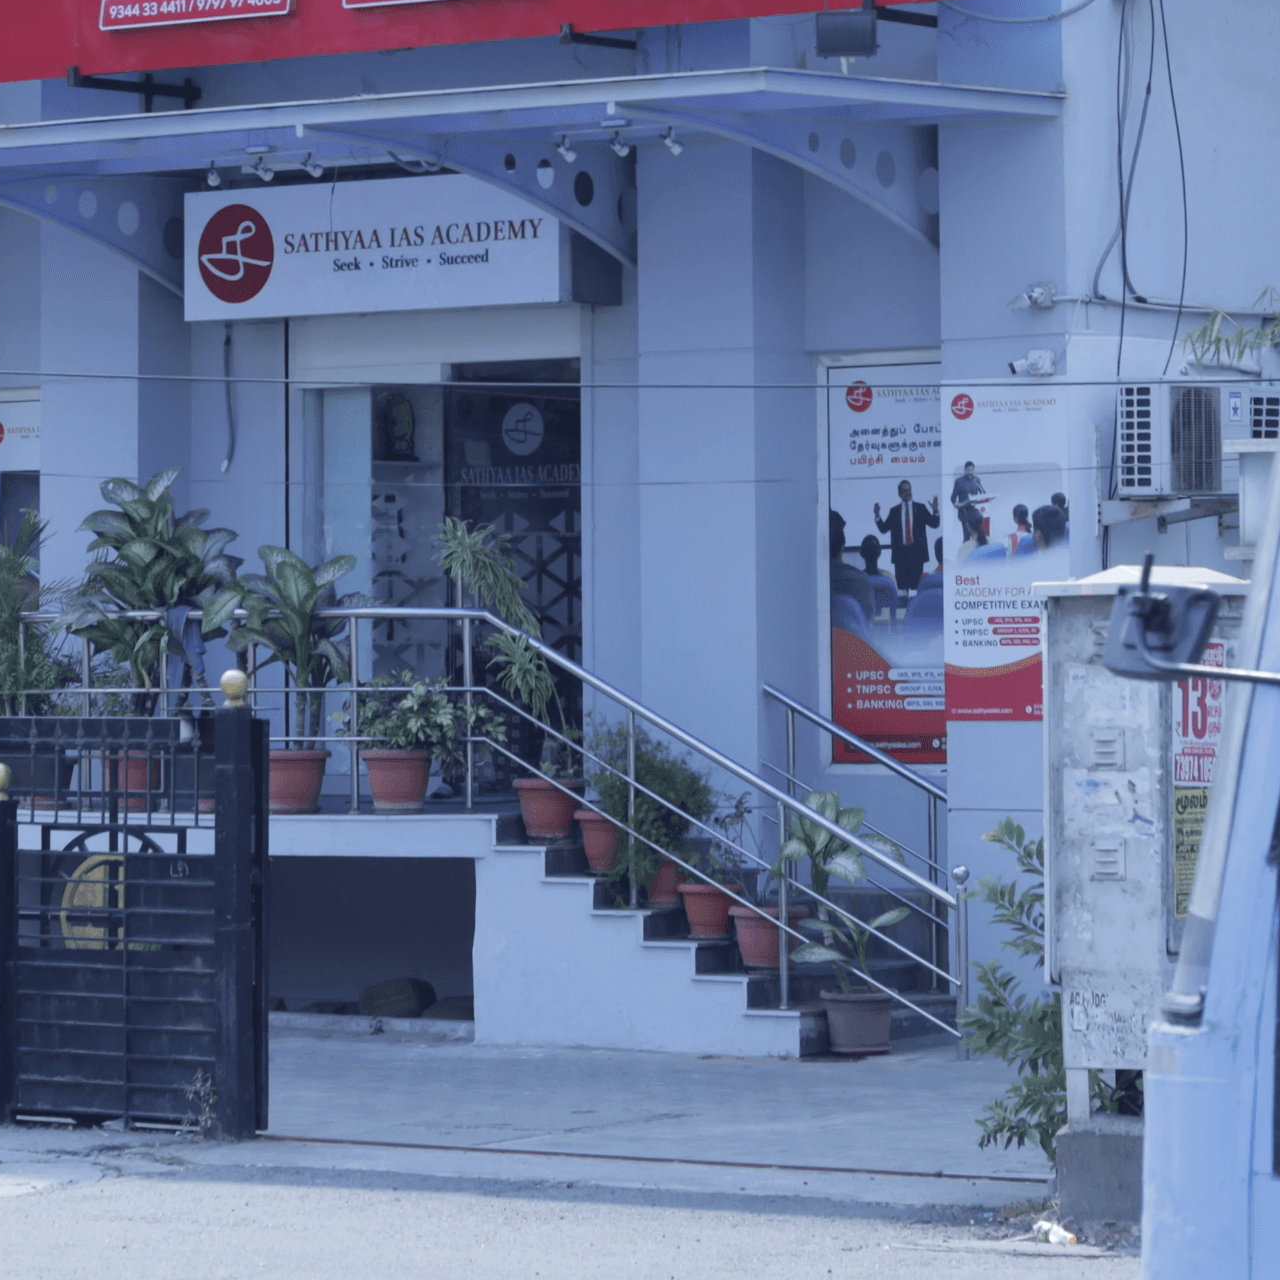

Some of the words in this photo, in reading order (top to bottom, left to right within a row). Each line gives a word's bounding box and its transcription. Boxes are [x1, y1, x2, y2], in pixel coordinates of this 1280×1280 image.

[109, 3, 140, 20] 9344
[143, 1, 157, 17] 33
[159, 0, 186, 15] 4411
[283, 228, 384, 255] SATHYAA
[389, 224, 425, 249] IAS
[431, 218, 544, 246] ACADEMY
[333, 257, 362, 272] Seek
[381, 255, 418, 270] Strive
[439, 249, 489, 266] Succeed
[955, 575, 980, 586] Best
[955, 587, 1003, 598] ACADEMY
[954, 600, 1018, 610] COMPETITIVE
[961, 618, 983, 626] UPSC
[961, 628, 989, 636] TNPSC
[962, 639, 998, 647] BANKING
[855, 670, 885, 681] UPSC
[856, 684, 891, 694] TNPSC
[856, 699, 904, 709] BANKING
